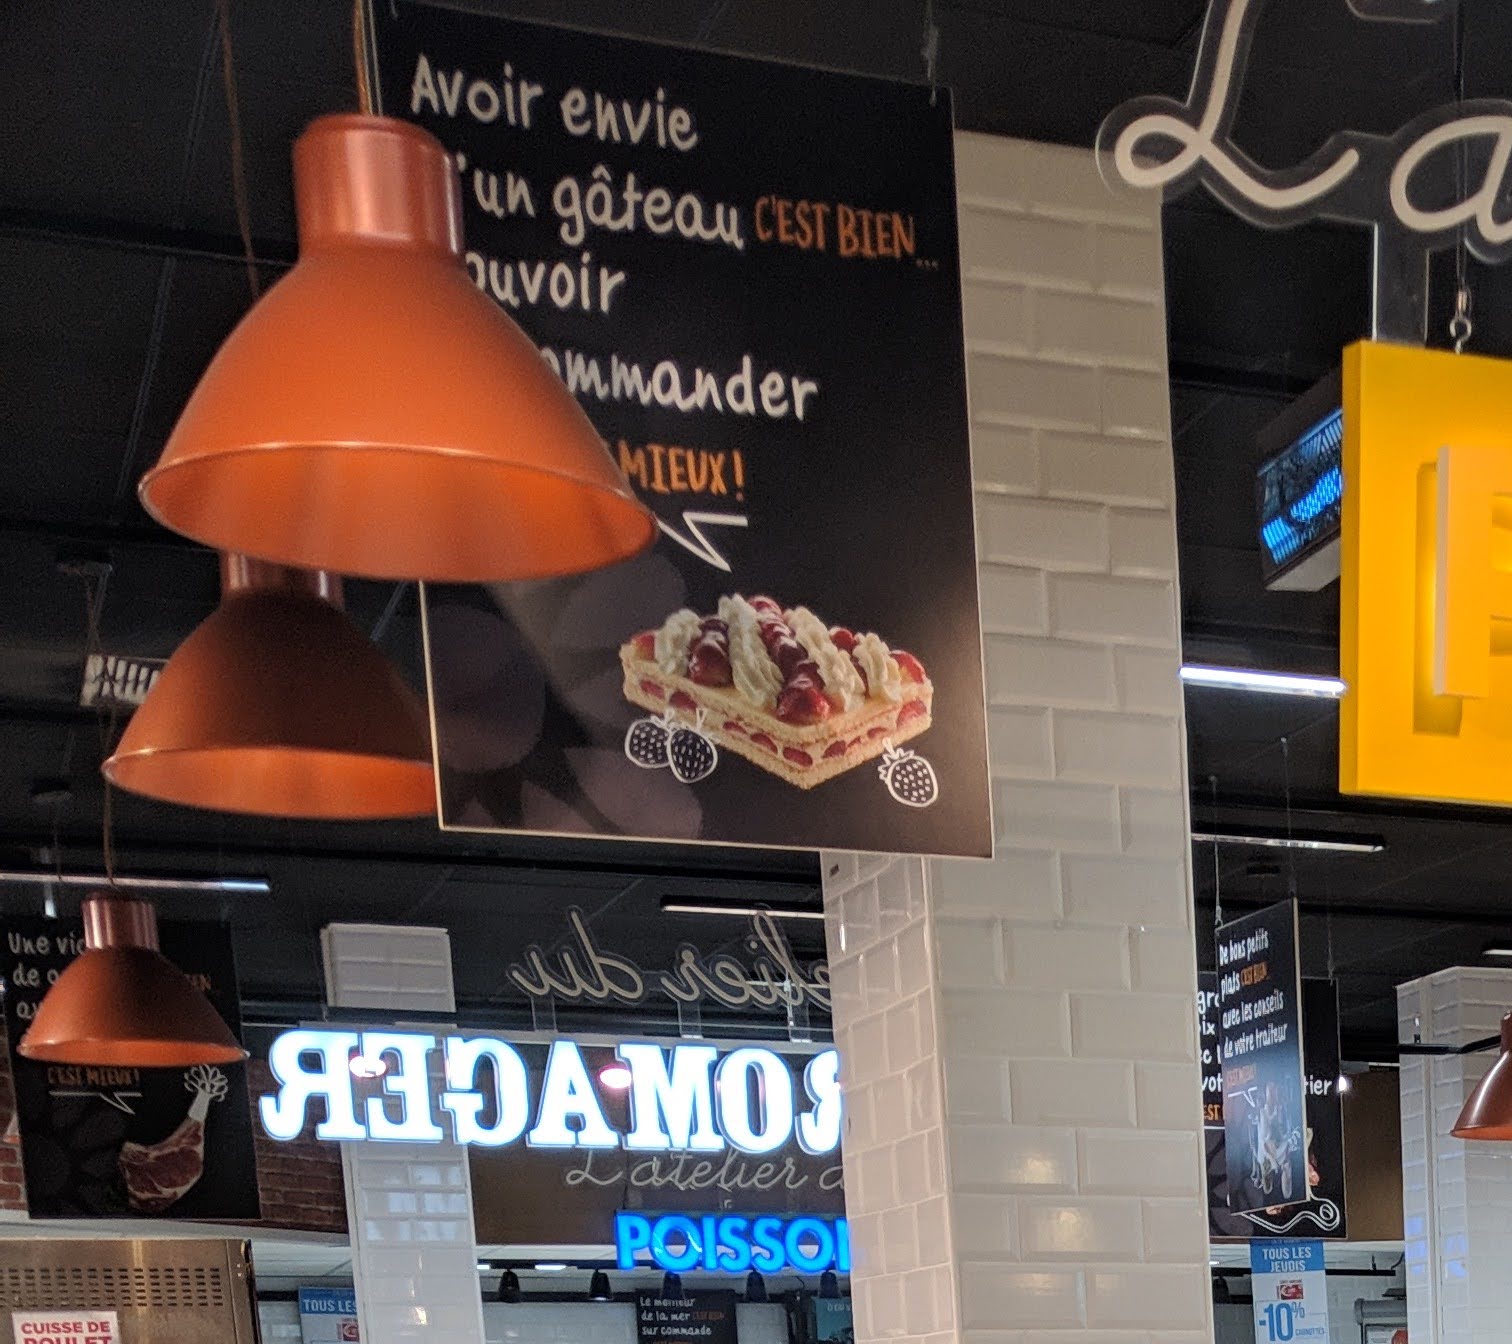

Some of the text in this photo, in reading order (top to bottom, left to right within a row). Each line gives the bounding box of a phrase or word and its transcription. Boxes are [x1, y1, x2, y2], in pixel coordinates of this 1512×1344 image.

[411, 52, 699, 151] Avoir envie
[456, 152, 536, 219] 'un
[552, 161, 744, 251] gâteau
[753, 195, 831, 252] C'EST
[8, 931, 51, 955] Une
[13, 962, 41, 988] de
[1241, 1001, 1253, 1022] les
[1253, 988, 1284, 1018] conseils
[566, 1150, 809, 1191] Latelier
[1262, 1246, 1312, 1260] TOUS LES
[1270, 1260, 1306, 1273] JEUDIS
[303, 1299, 336, 1312] TOUS
[21, 1321, 111, 1334] CUISSE DE
